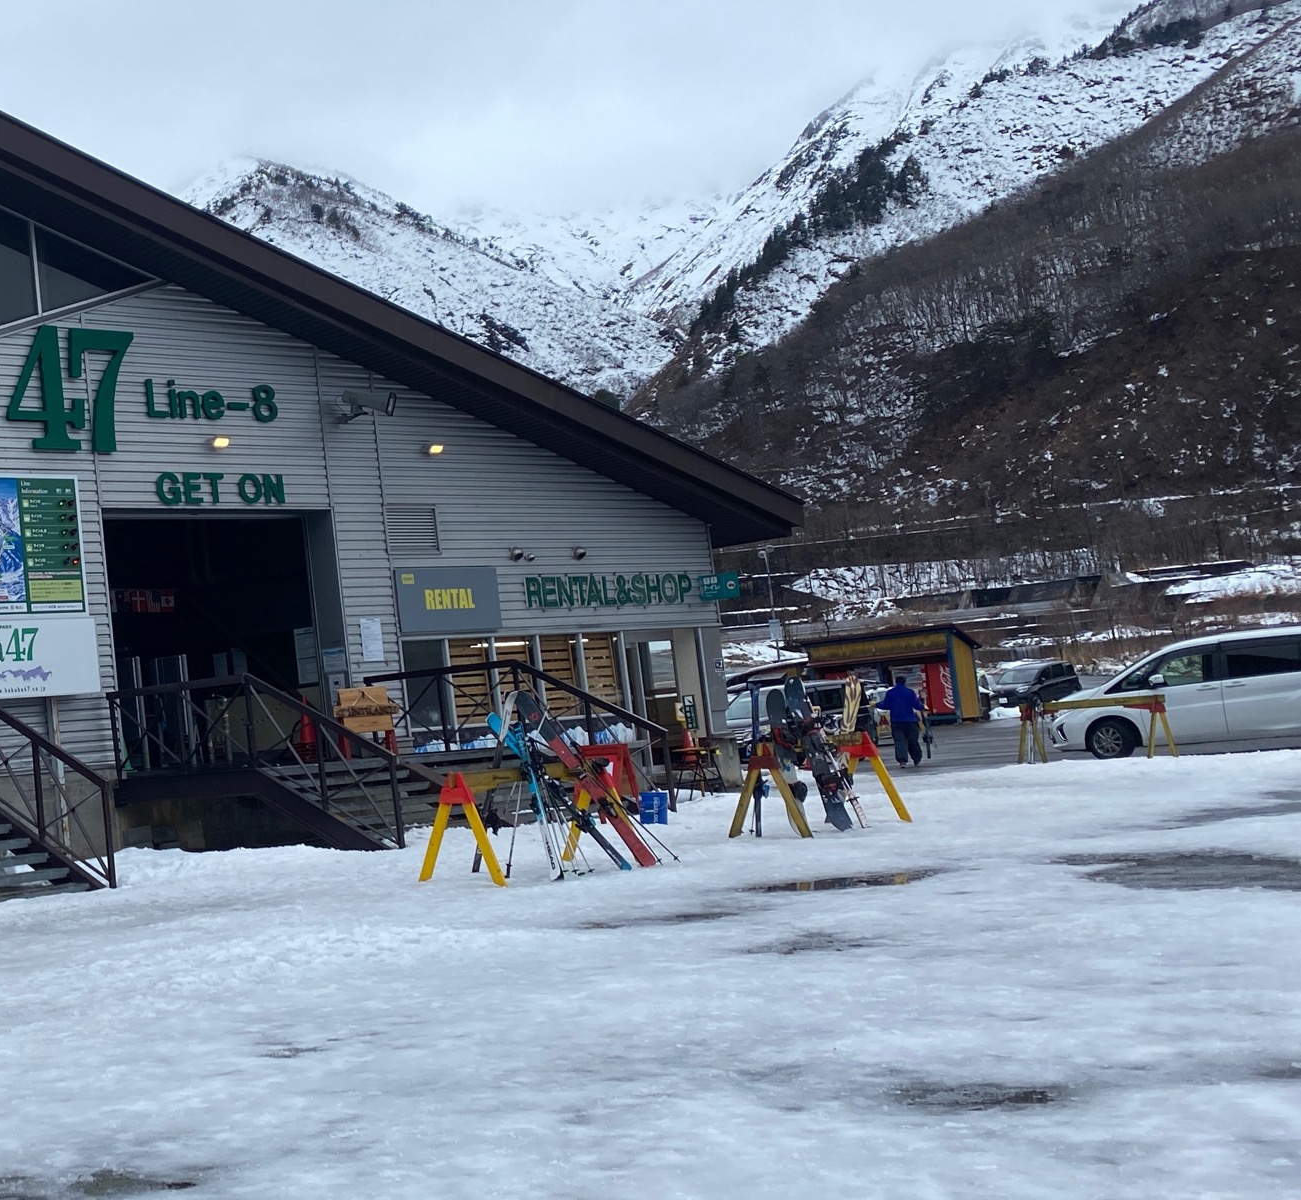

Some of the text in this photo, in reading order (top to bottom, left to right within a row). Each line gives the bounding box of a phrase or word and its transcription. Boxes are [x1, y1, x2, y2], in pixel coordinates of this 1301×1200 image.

[6, 324, 134, 455] 47
[144, 378, 278, 422] Line-8
[156, 471, 286, 505] GET ON
[424, 588, 476, 610] RENTAL
[525, 573, 693, 608] RENTAL&SHOP
